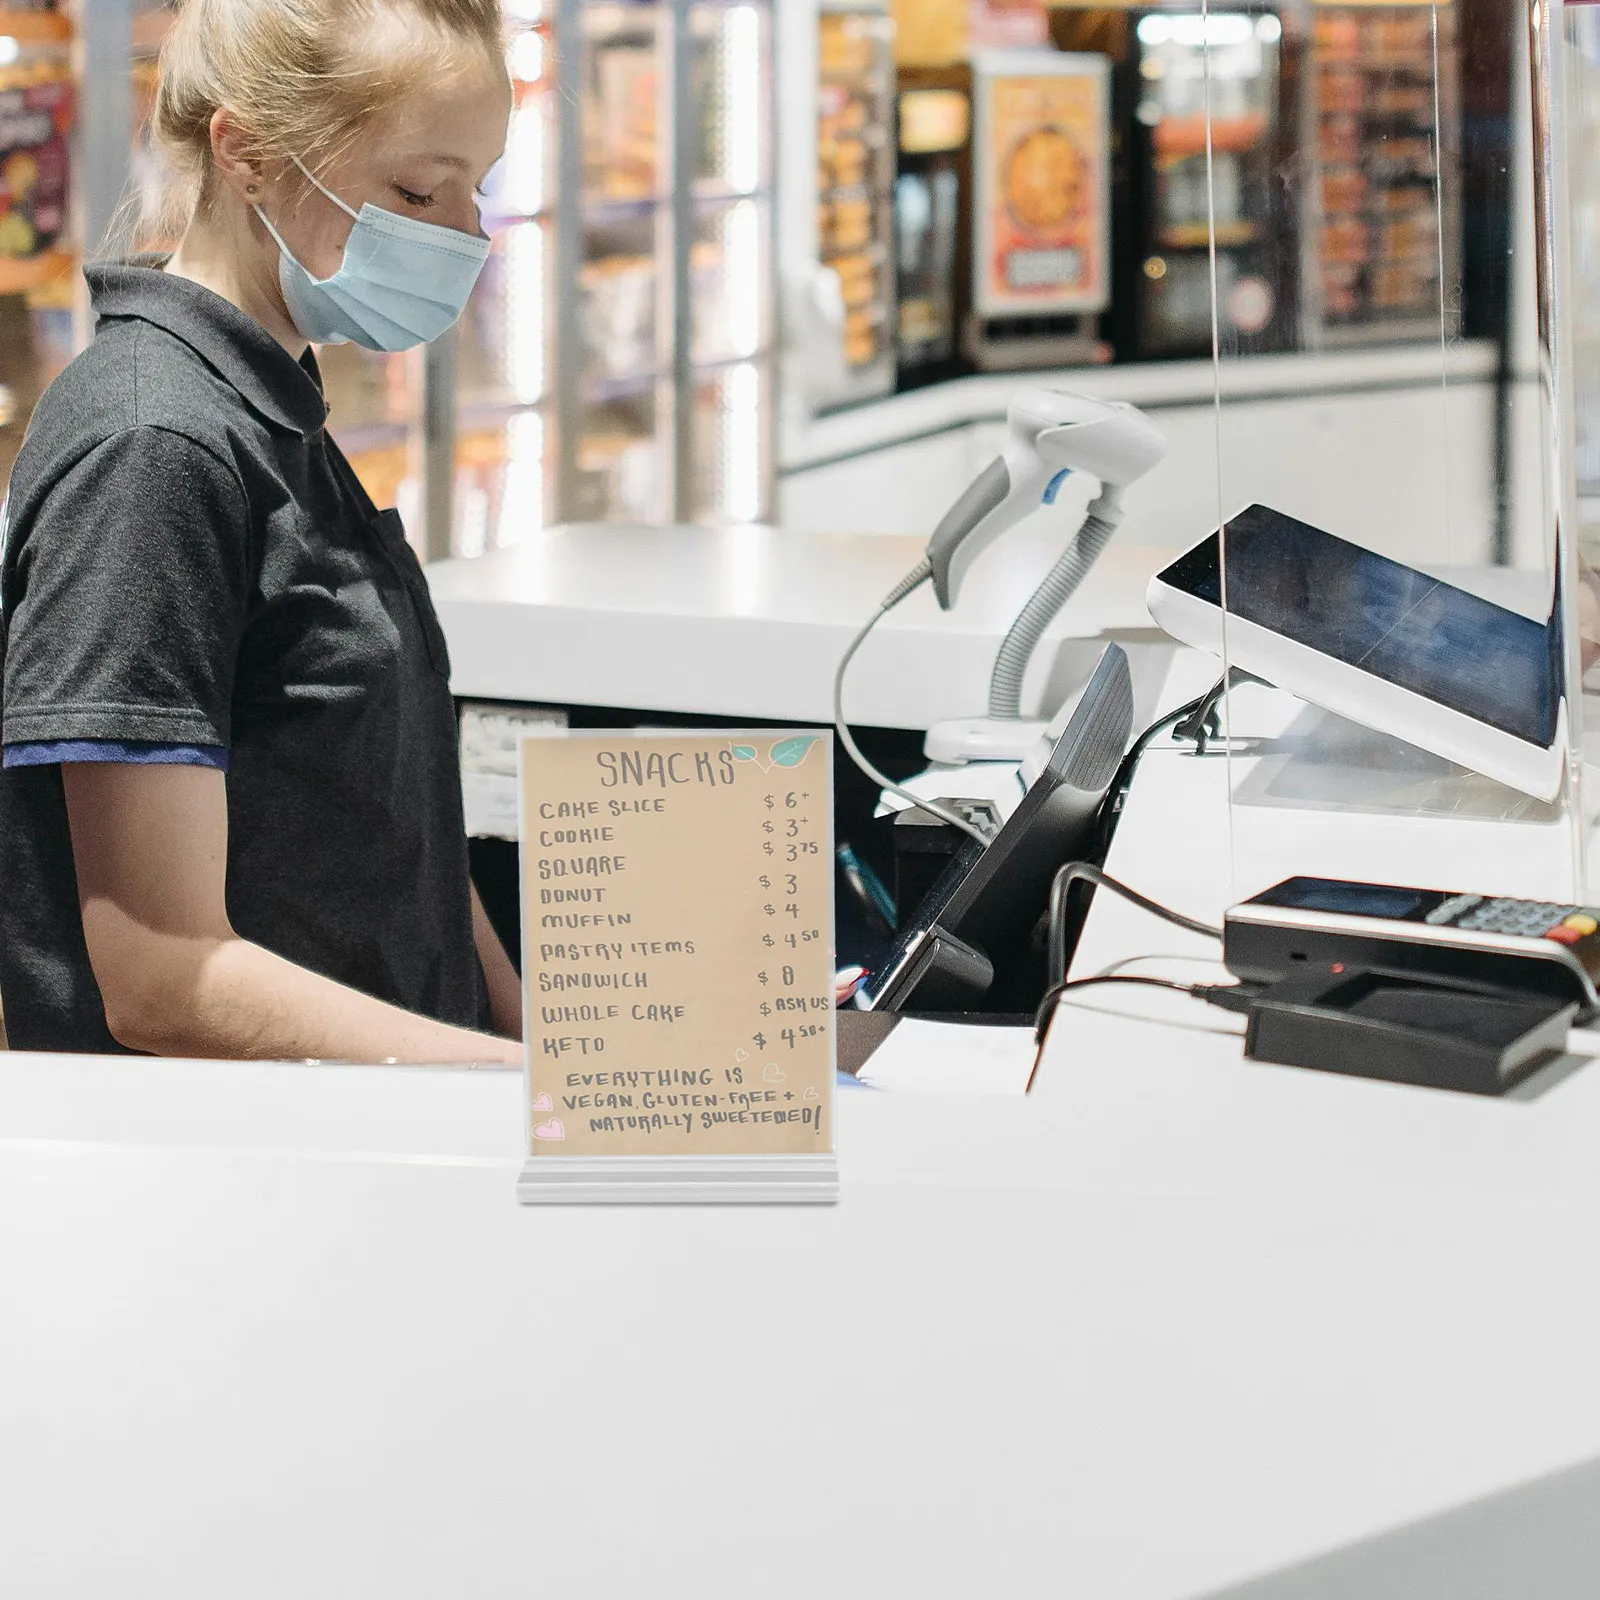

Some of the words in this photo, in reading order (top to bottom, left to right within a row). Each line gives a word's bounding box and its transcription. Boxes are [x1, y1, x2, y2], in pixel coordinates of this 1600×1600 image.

[597, 750, 736, 788] SNACKS
[539, 801, 599, 820] CAKE
[607, 798, 666, 817] SLICE
[539, 826, 614, 848] COOKIE
[538, 855, 626, 880] SQUARE
[784, 873, 798, 895] 3
[540, 887, 606, 905] DONUT
[541, 912, 632, 929] MUFFIN
[785, 903, 800, 919] 4
[540, 942, 623, 962] PASTRY
[630, 940, 695, 957] ITEMS
[538, 971, 648, 993] SANDWICH
[541, 1004, 619, 1024] WHOLE
[631, 1004, 685, 1023] CAKE
[775, 997, 807, 1013] ASK
[810, 996, 829, 1011] US
[542, 1036, 605, 1059] KETO
[566, 1068, 714, 1089] EVERYTHING
[724, 1066, 744, 1085] IS
[642, 1090, 777, 1110] GLUTEN-FREE
[589, 1112, 693, 1134] NATURALLY
